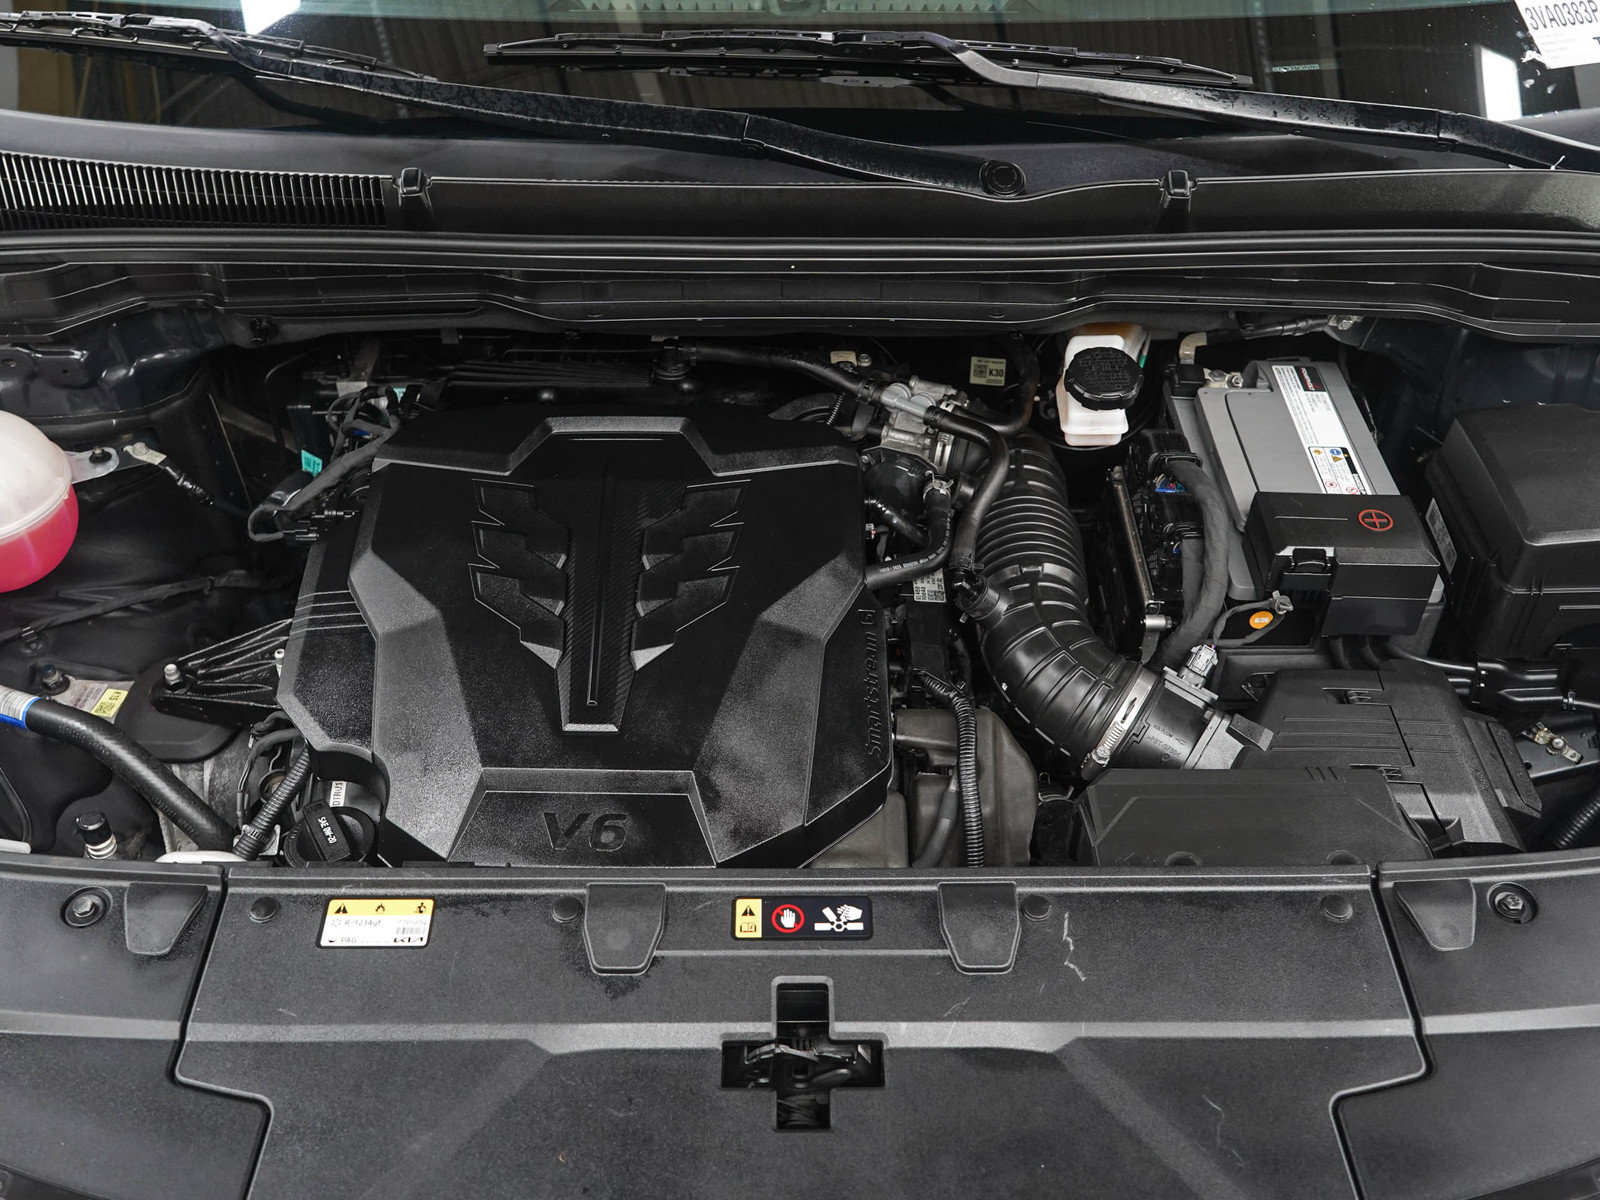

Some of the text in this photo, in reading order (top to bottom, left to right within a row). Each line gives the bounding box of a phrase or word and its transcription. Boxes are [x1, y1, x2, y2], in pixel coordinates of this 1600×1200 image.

[863, 631, 882, 756] Smartstream
[318, 816, 330, 829] SAE
[542, 812, 628, 852] V6
